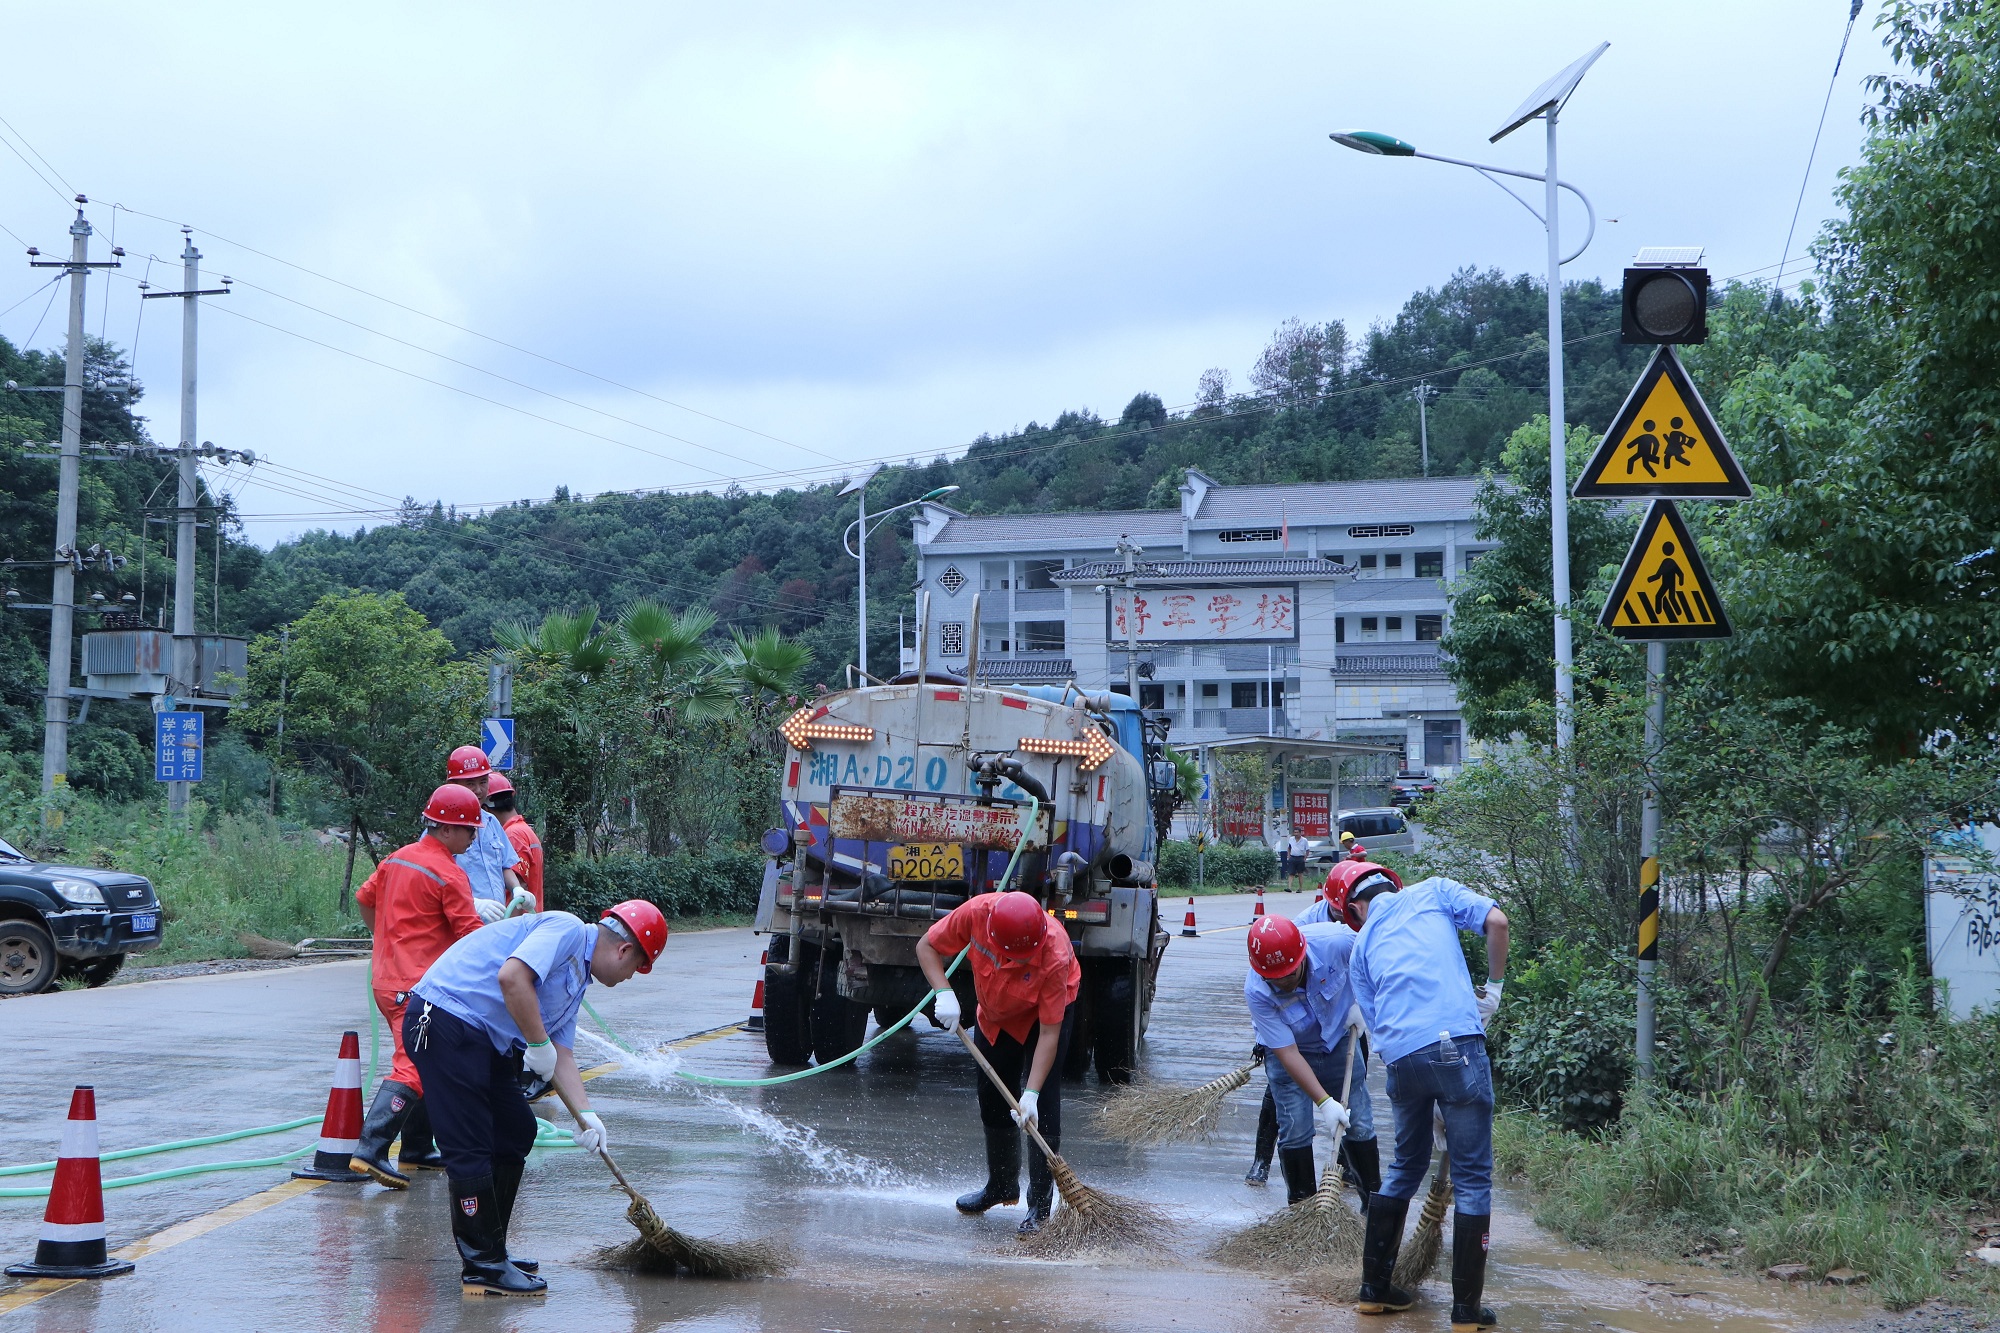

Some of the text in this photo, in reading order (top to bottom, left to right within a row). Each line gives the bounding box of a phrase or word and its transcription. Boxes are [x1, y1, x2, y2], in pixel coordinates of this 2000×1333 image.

[162, 717, 177, 777] 学校出口
[181, 717, 198, 778] 减速慢行
[1294, 795, 1328, 809] 服务三农发展
[1294, 811, 1328, 825] 助力乡村振兴
[891, 857, 960, 879] D2062
[127, 890, 143, 899] JMC
